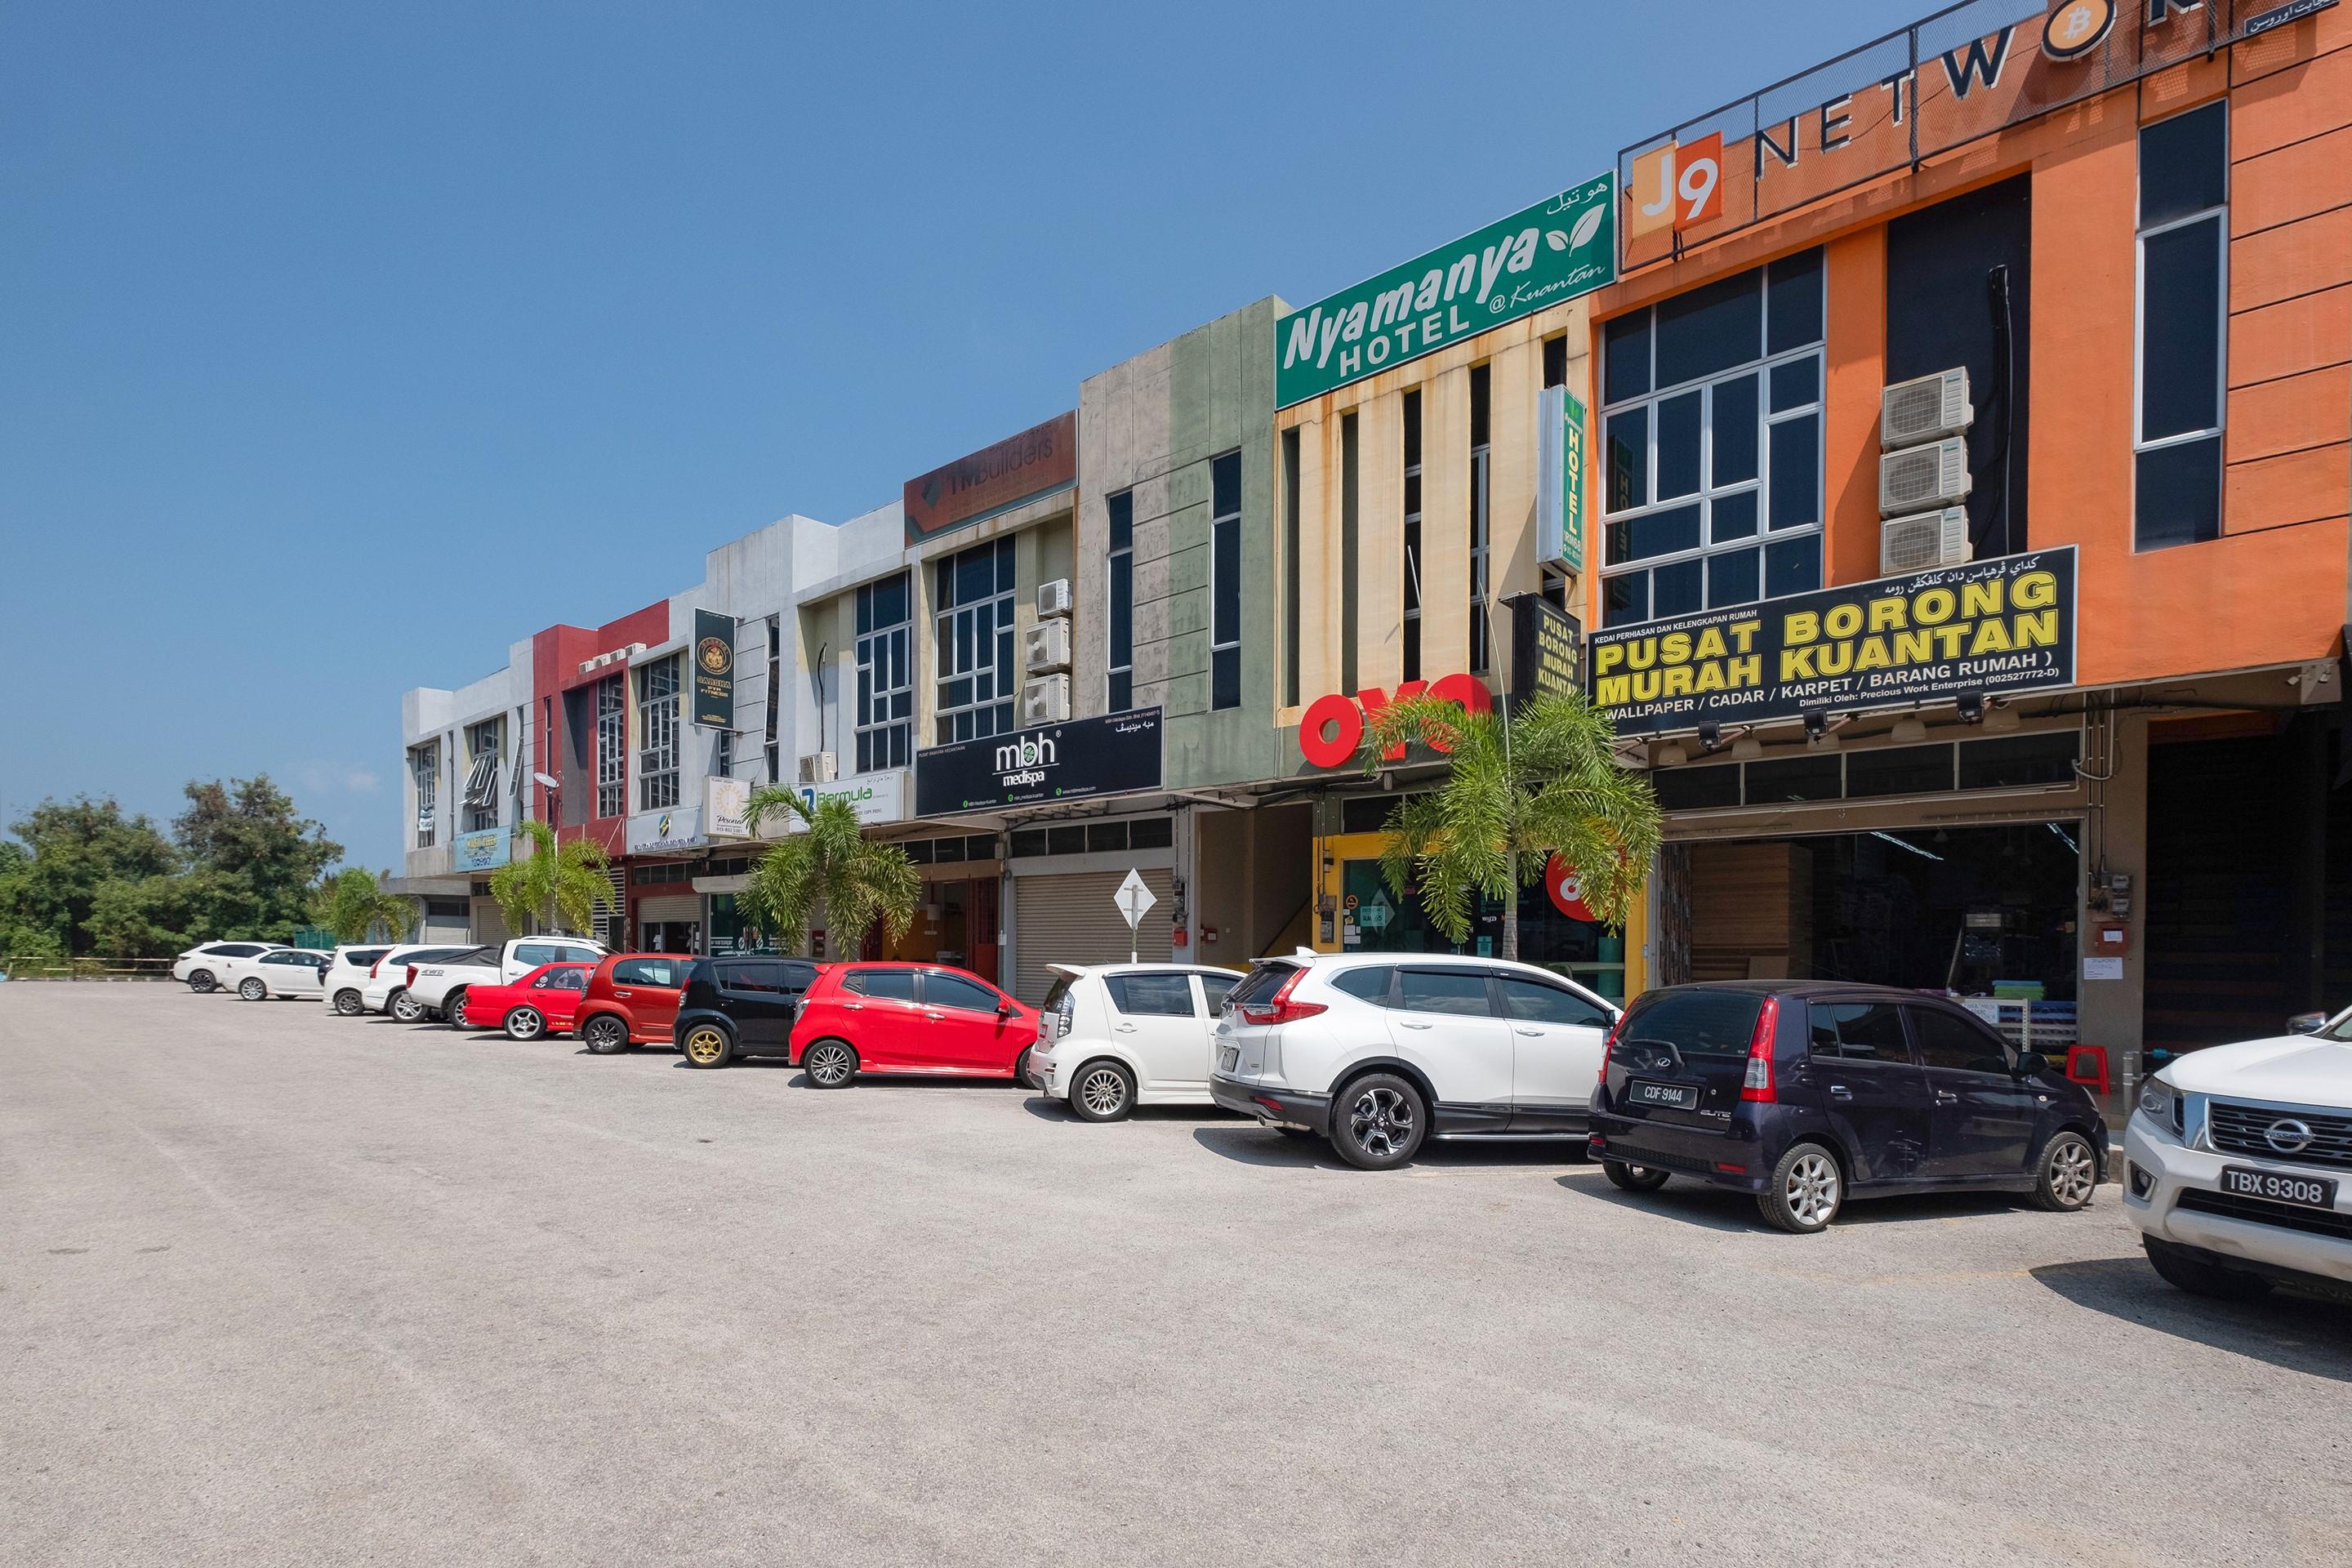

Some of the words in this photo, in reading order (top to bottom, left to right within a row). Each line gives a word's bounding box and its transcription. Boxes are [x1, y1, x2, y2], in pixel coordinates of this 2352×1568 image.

[1641, 153, 1719, 221] J9
[1284, 228, 1539, 369] Nyamanya
[1490, 295, 1505, 314] @
[1509, 263, 1606, 309] Kuantan
[1339, 305, 1470, 377] HOTEL
[1569, 427, 1579, 535] HOTEL
[1544, 615, 1573, 644] PUSAT
[1595, 635, 1615, 644] KEDAI
[1616, 628, 1655, 641] PERHIASAN
[1656, 624, 1672, 634] DAN
[1673, 615, 1727, 630] KELENGKAPAN
[1729, 610, 1757, 621] RUMAH
[1596, 620, 1761, 675] PUSAT
[1784, 571, 2056, 646] BORONG
[1539, 630, 1577, 665] BORONG
[1543, 652, 1574, 679] MURAH
[1597, 654, 1762, 706] MURAH
[1780, 609, 2059, 682] KUANTAN
[1605, 699, 1694, 720] WALLPAPER
[1709, 690, 1764, 707] CADAR
[1781, 678, 1852, 698] KARPET
[1870, 665, 1950, 687] BARANG
[1958, 653, 2037, 676] RUMAH
[1799, 696, 1832, 707] Dimiliki
[1834, 693, 1858, 704] Oleh:
[1860, 688, 1901, 700] Precious
[1904, 684, 1929, 695] Work
[1931, 678, 1983, 691] Enterprise
[1985, 667, 2060, 686] (002527772-D)
[996, 732, 1055, 771] mbh
[1003, 770, 1045, 787] medispa
[1645, 1086, 1662, 1100] CDF
[1662, 1088, 1683, 1102] 9144
[2227, 1170, 2263, 1195] TBX
[2266, 1177, 2323, 1204] 9308
